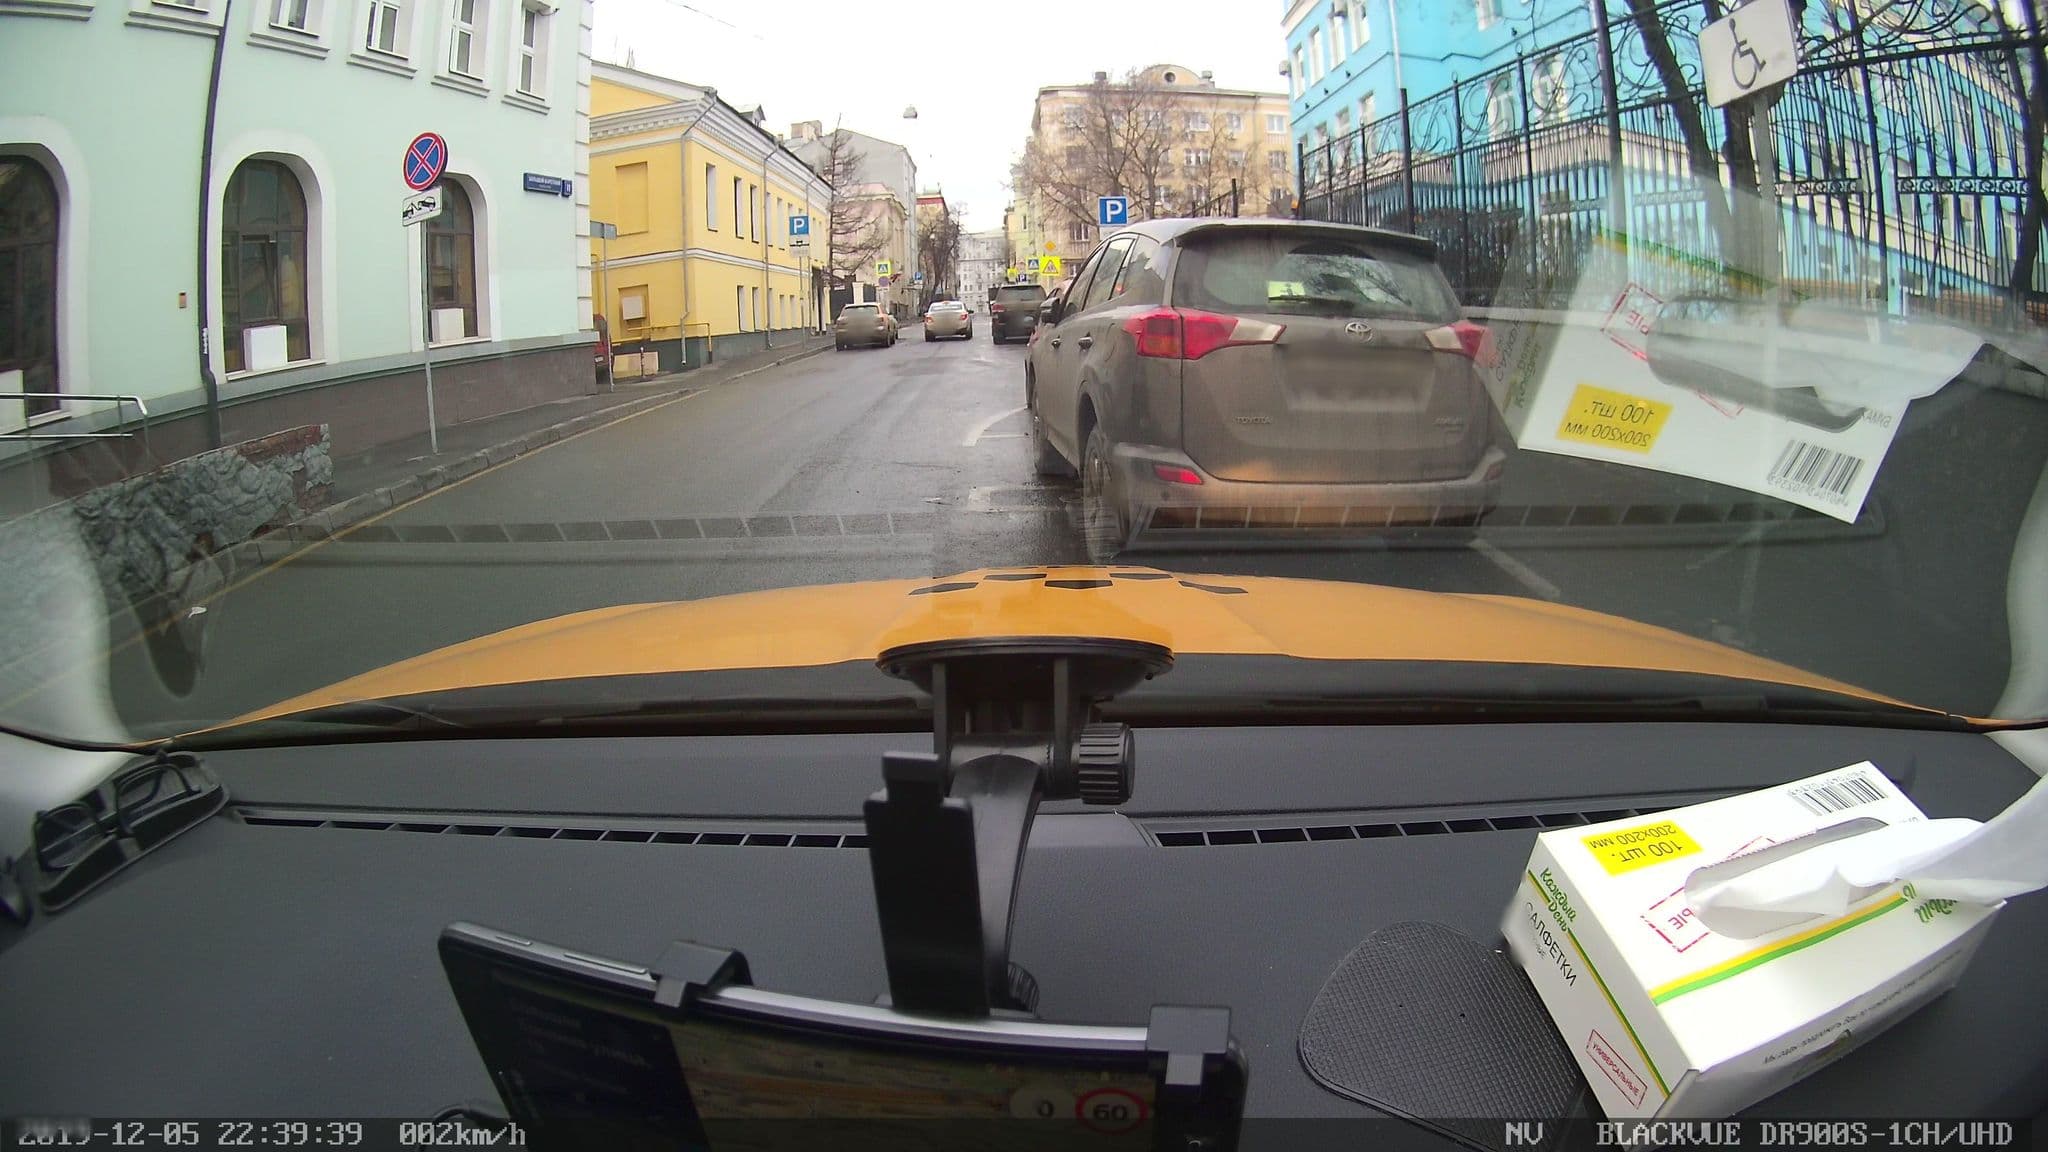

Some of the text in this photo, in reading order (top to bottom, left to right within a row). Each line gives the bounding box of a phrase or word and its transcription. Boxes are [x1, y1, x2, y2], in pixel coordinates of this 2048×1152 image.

[1106, 200, 1123, 223] P
[793, 218, 805, 234] P
[1648, 840, 1683, 857] 100
[1539, 867, 1577, 922] Каждый
[1547, 901, 1569, 932] День
[1037, 1099, 1054, 1119] 0
[1092, 1103, 1128, 1121] 60
